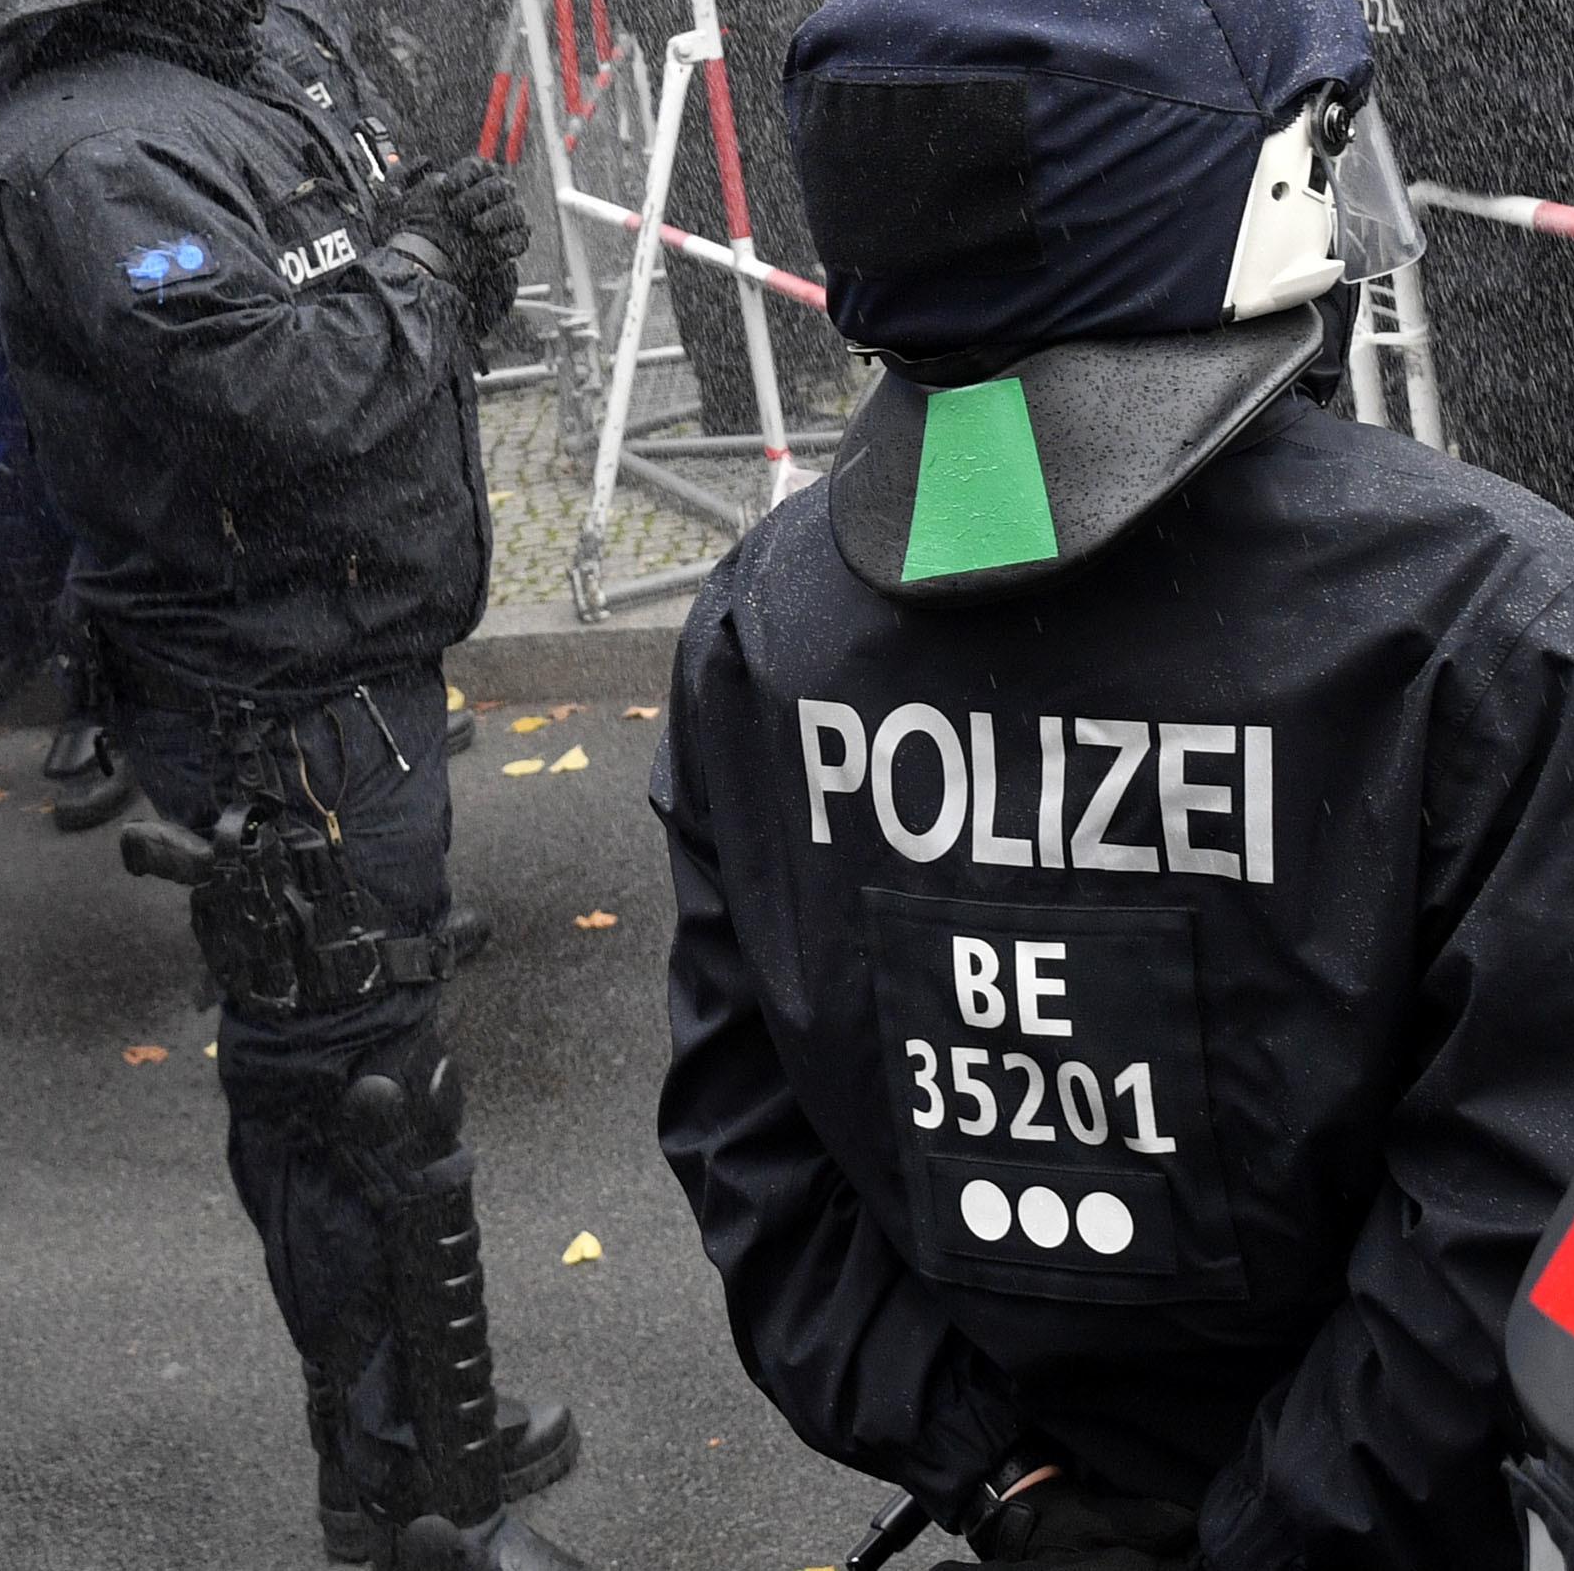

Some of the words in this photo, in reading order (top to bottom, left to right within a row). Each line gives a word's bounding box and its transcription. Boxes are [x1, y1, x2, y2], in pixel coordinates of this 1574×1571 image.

[797, 698, 1274, 884] POLIZEI
[952, 935, 1073, 1037] BE
[905, 1038, 1177, 1154] 35201
